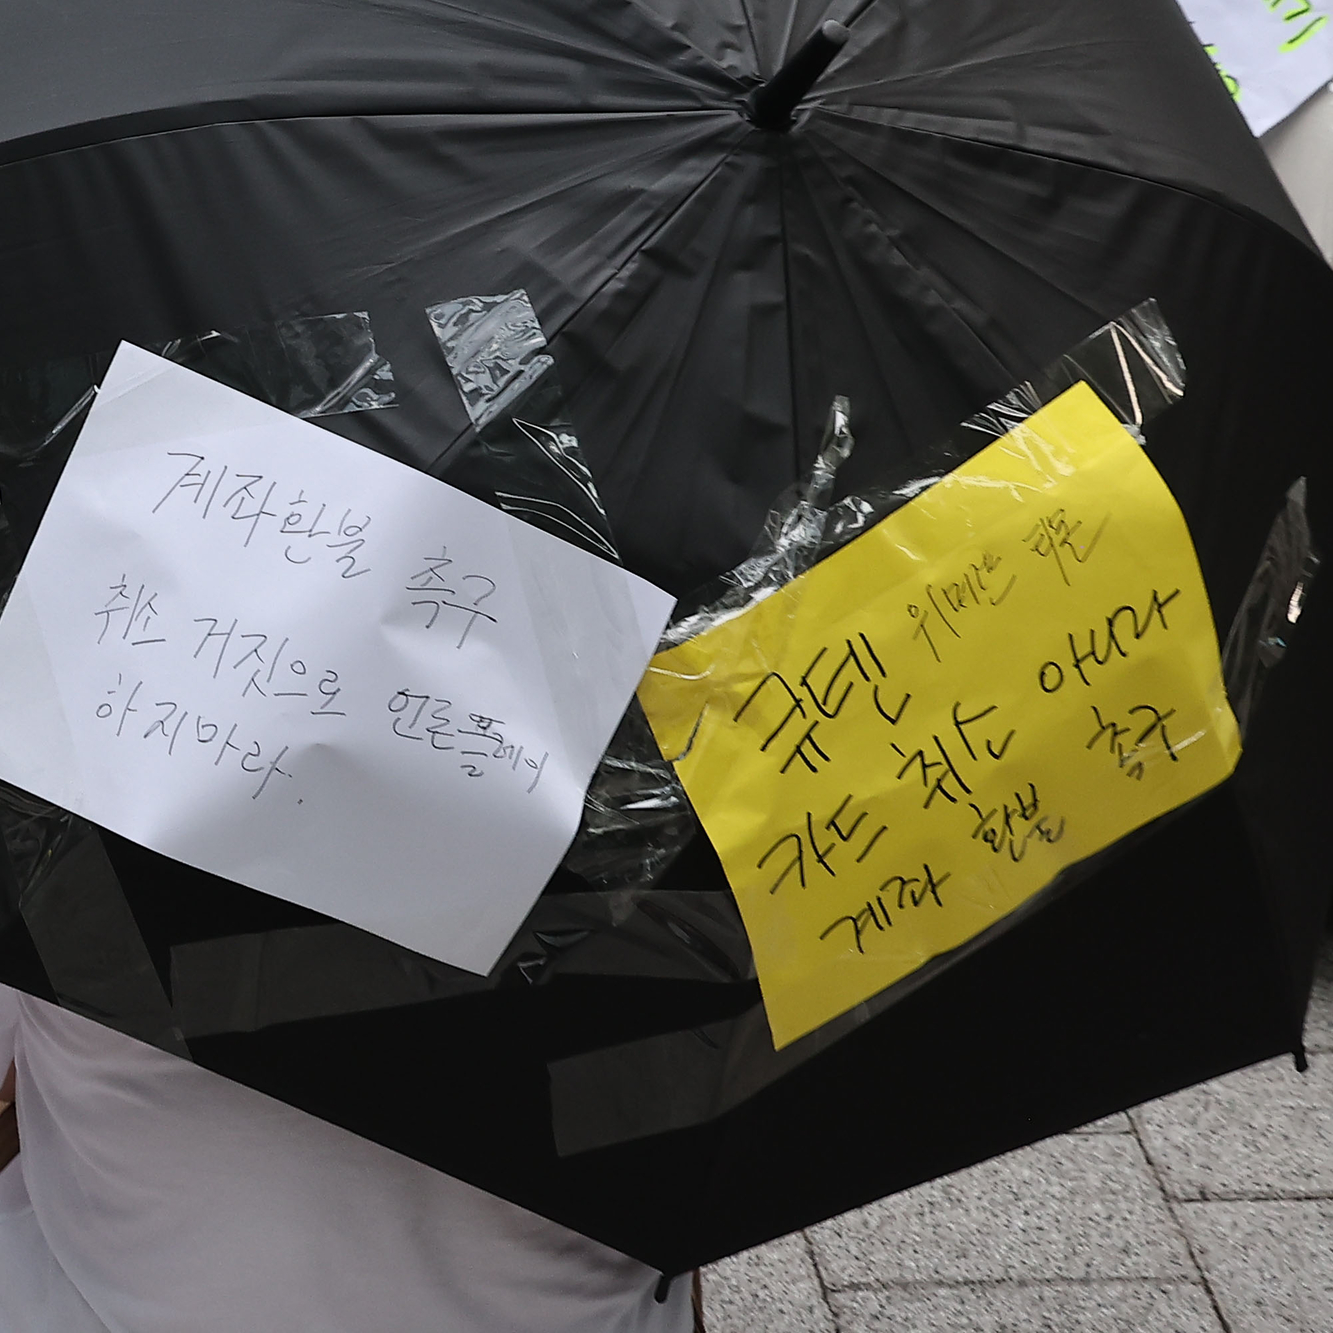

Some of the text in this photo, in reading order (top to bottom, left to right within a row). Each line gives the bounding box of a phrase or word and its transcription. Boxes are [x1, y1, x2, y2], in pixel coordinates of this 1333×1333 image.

[151, 451, 499, 649] 계좌환불 촉구
[94, 573, 167, 647] 취소
[192, 616, 347, 717] 거짓으로
[732, 631, 912, 776] 큐텐
[756, 794, 889, 895] 카드
[891, 700, 1018, 810] 취소
[819, 862, 953, 956] 계좌
[969, 782, 1068, 863] 환불
